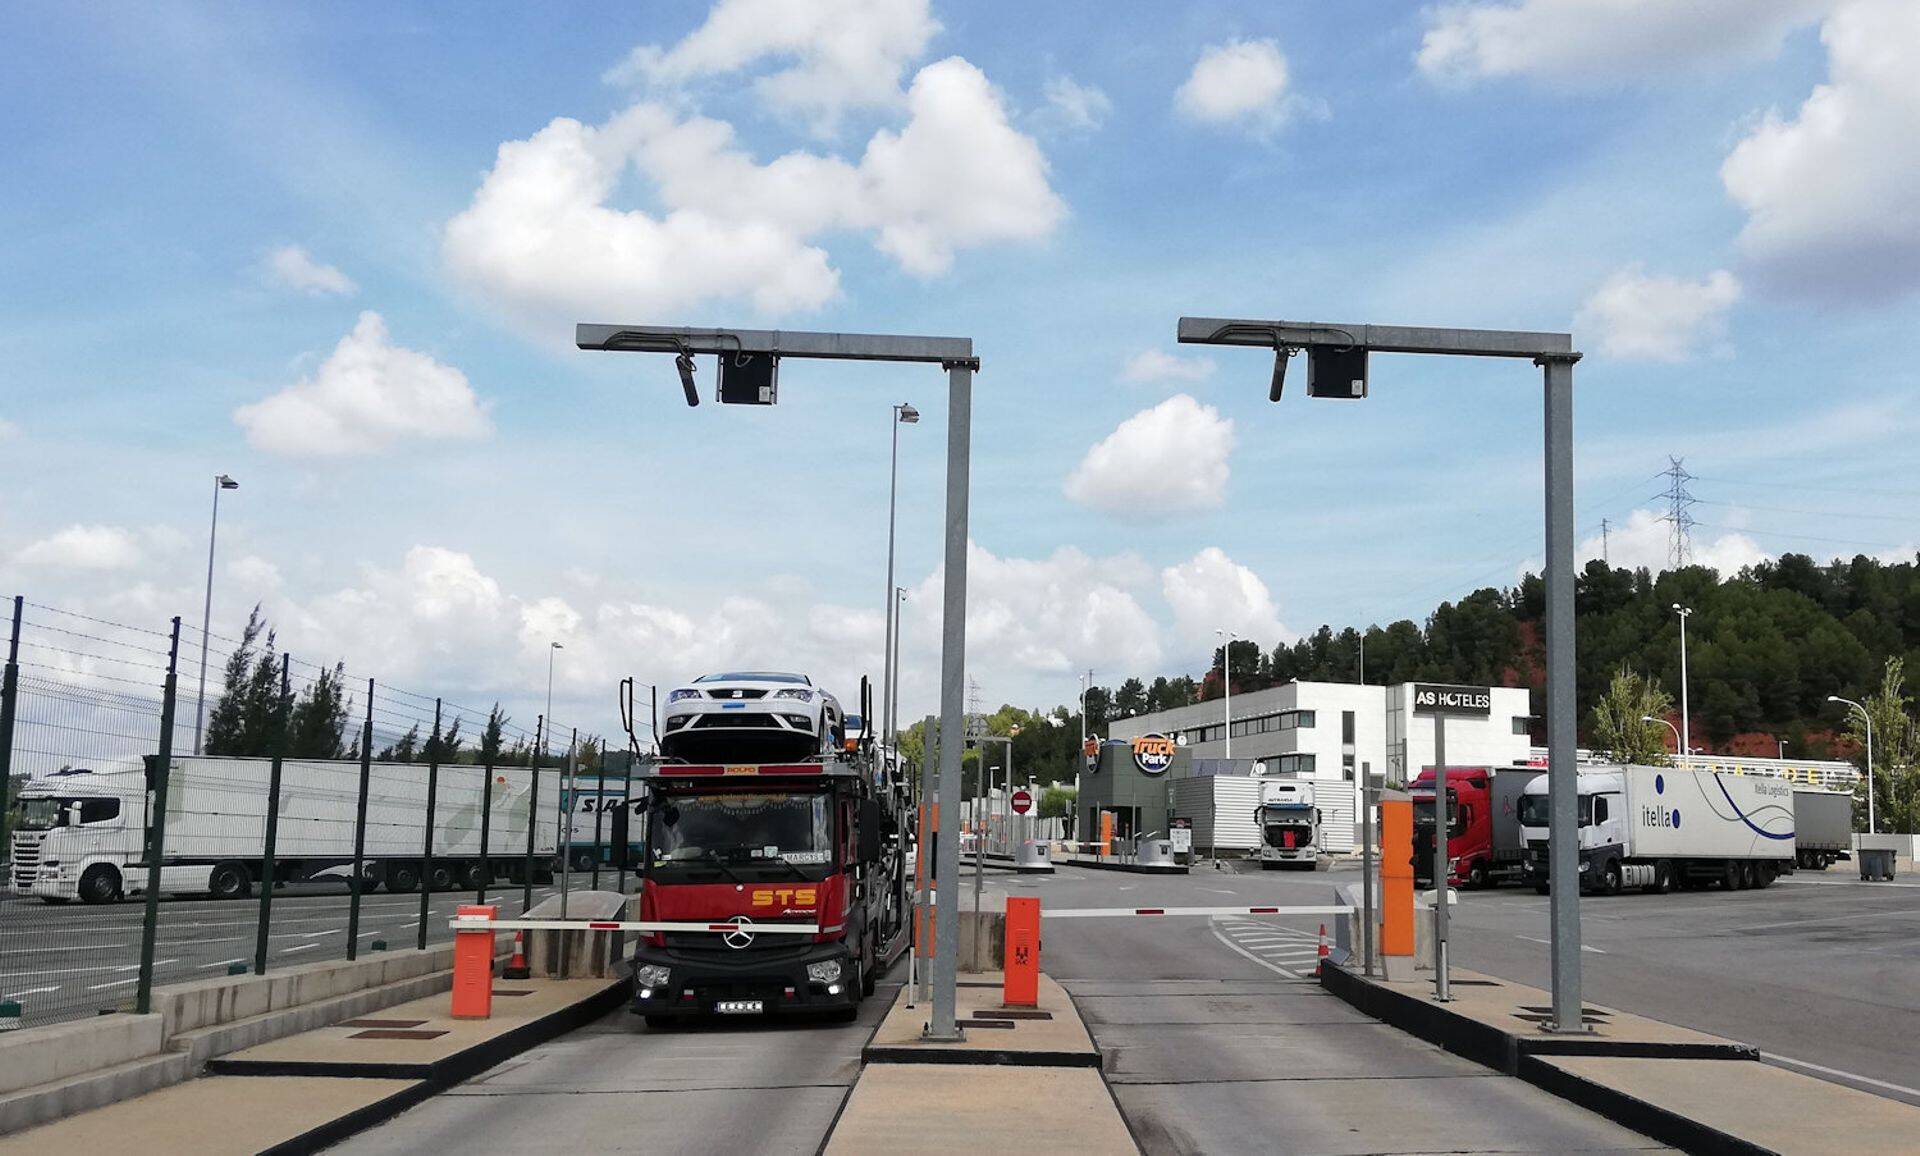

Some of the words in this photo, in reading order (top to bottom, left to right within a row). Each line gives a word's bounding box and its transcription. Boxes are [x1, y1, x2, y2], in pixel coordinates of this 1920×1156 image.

[1416, 691, 1436, 705] AS
[1438, 692, 1490, 708] HOTELES
[1132, 737, 1176, 755] Truck
[1142, 752, 1168, 765] Park
[1642, 804, 1671, 827] itella
[751, 889, 817, 906] STS
